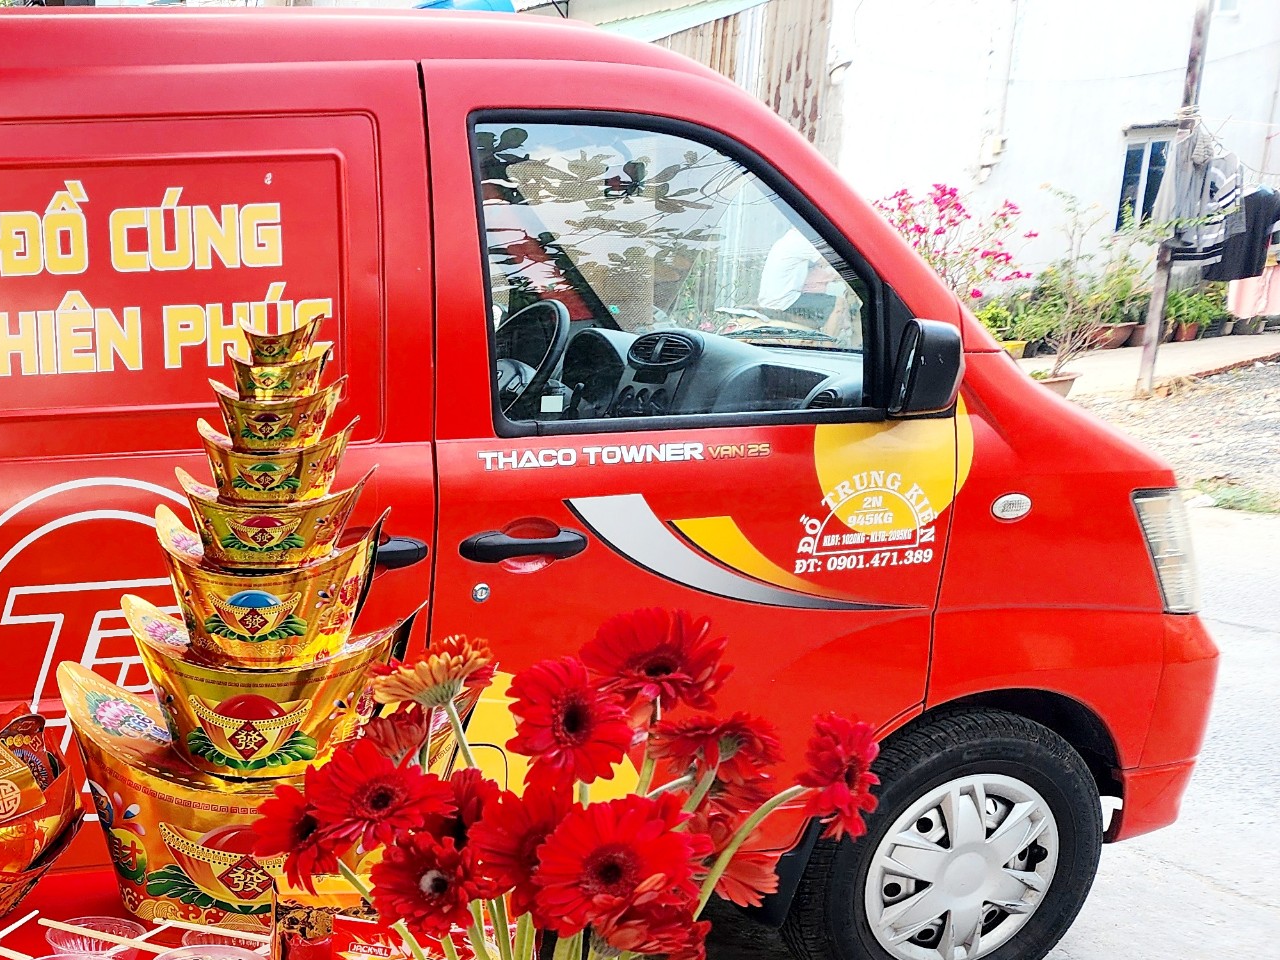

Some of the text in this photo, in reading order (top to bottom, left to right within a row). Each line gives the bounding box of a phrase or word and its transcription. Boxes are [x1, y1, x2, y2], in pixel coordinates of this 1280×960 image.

[109, 187, 283, 272] CÚNG
[477, 451, 577, 470] THACO
[582, 443, 705, 465] TOWNER
[707, 445, 745, 459] VAN
[821, 471, 902, 511] TRUNG
[848, 512, 893, 525] 945KG
[794, 549, 933, 574] ĐT: 0901.471.389
[235, 731, 260, 752] 發
[230, 866, 269, 892] 發
